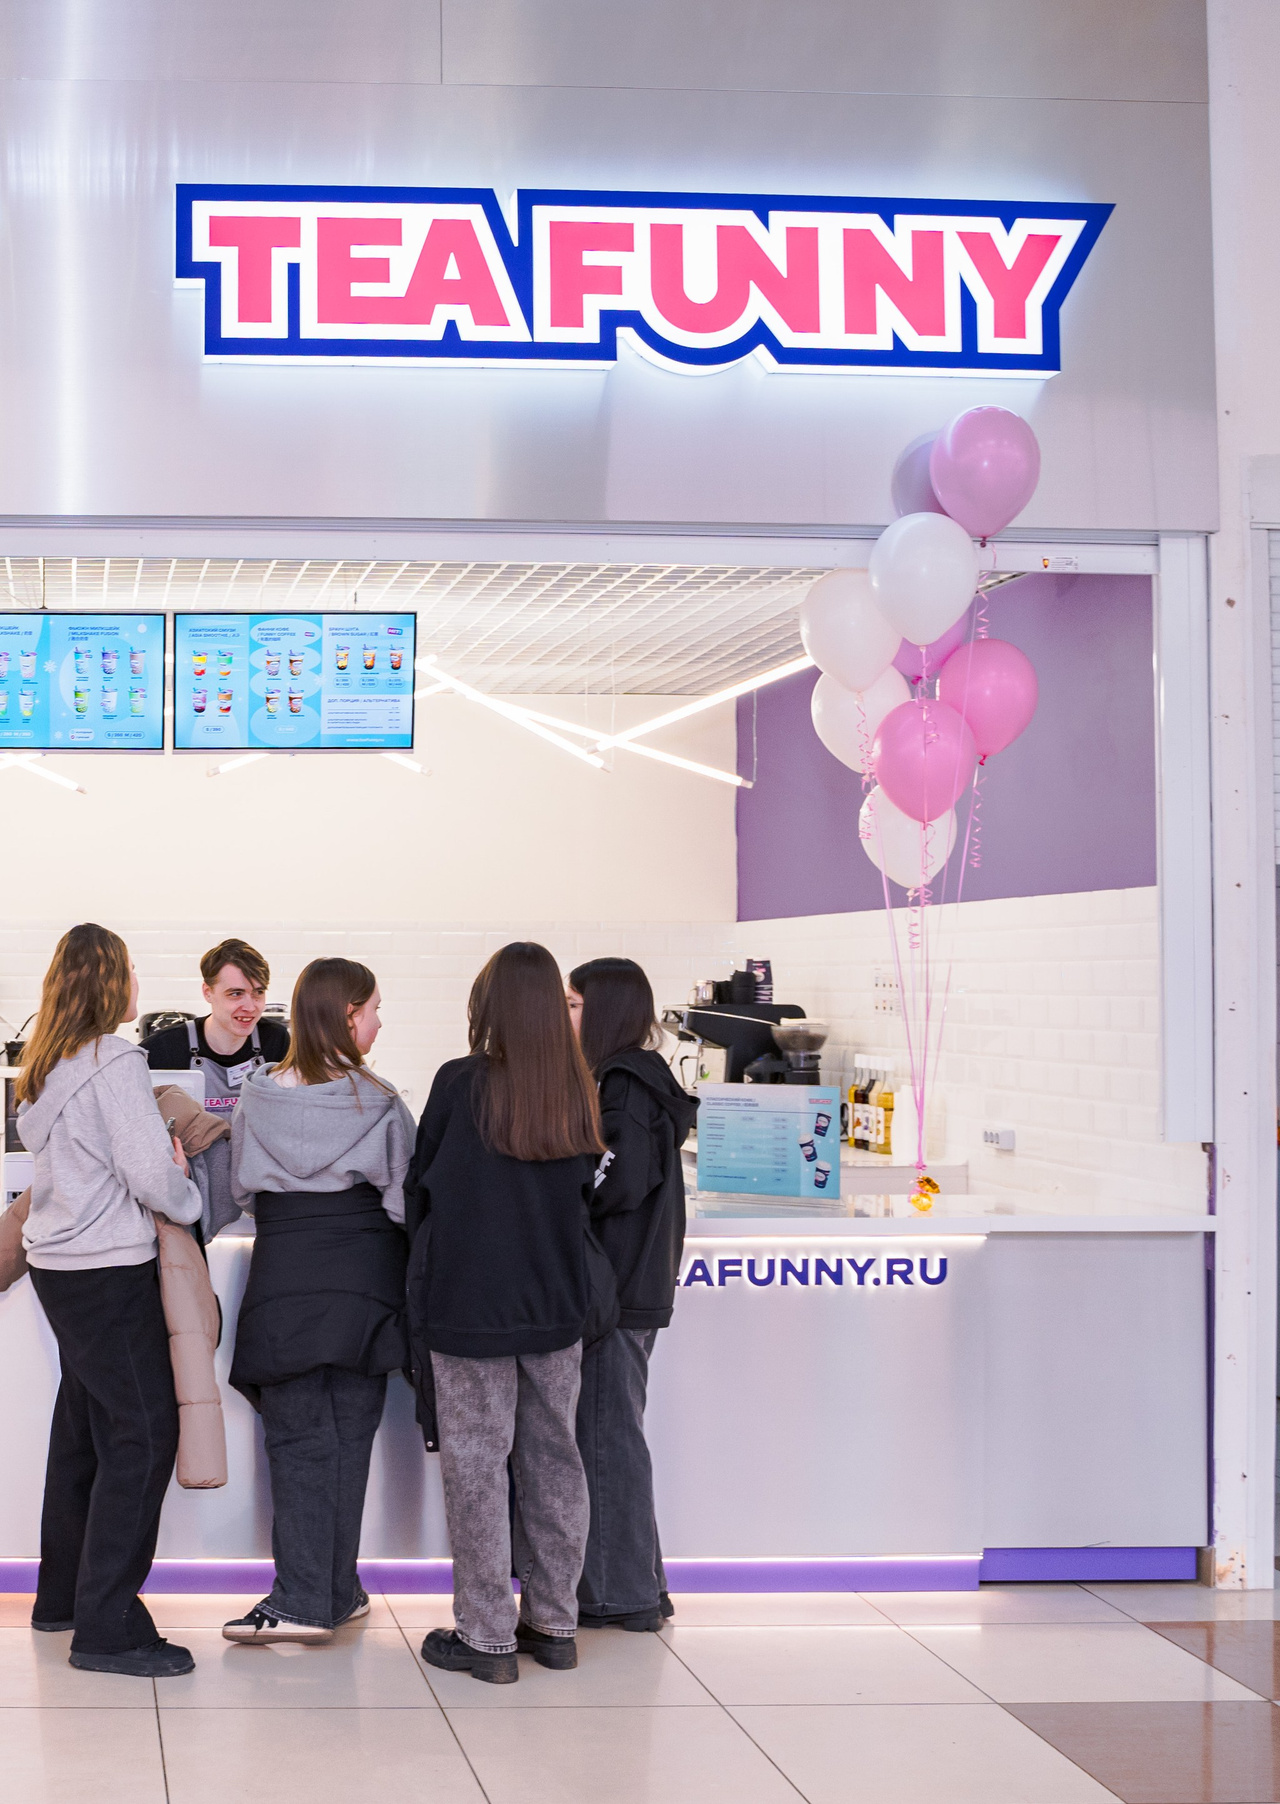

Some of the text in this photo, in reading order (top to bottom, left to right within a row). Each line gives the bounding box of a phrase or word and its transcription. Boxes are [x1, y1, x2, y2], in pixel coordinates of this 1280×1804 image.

[209, 215, 1062, 339] TEA FUNNY
[675, 1257, 948, 1287] AFUNNY.RU
